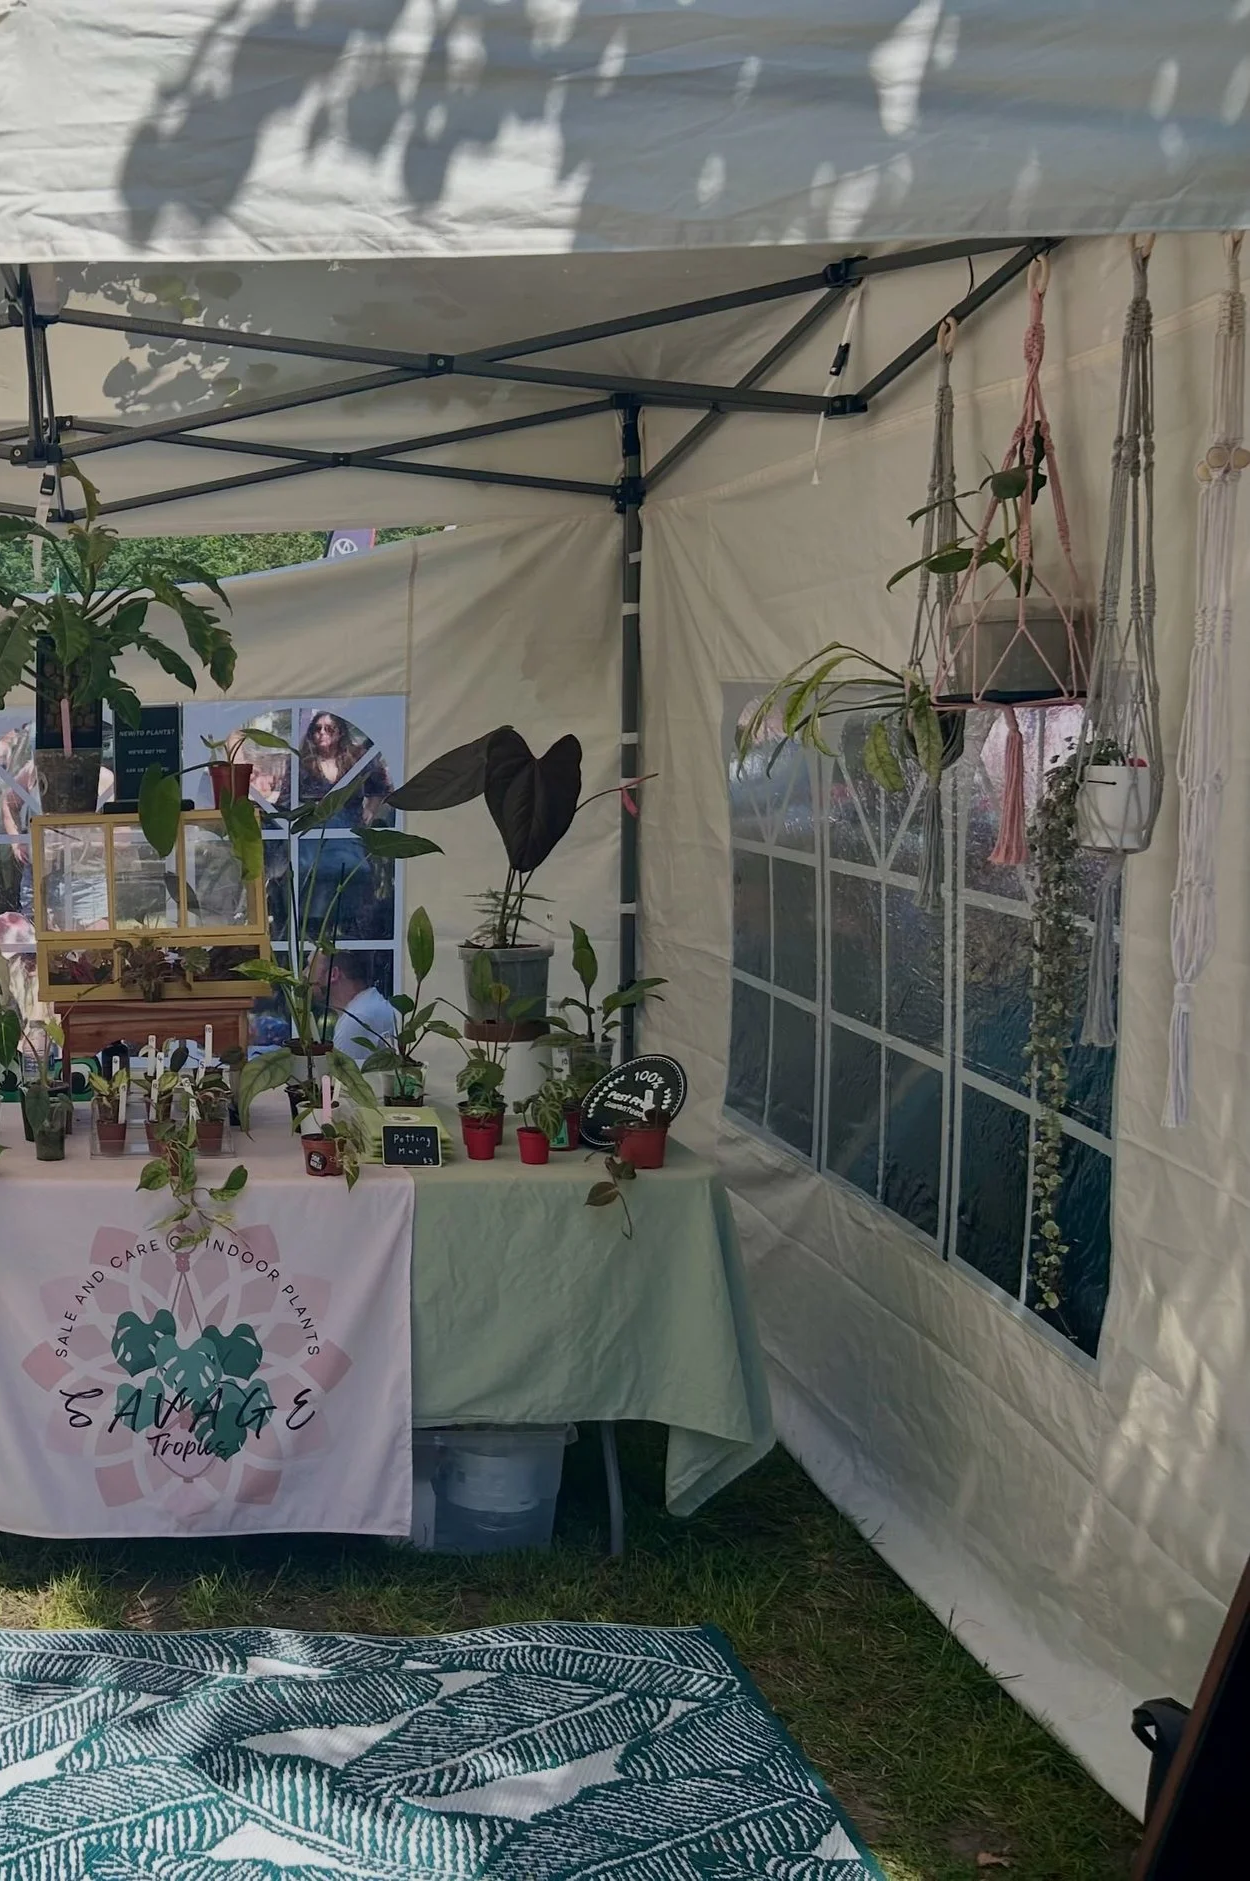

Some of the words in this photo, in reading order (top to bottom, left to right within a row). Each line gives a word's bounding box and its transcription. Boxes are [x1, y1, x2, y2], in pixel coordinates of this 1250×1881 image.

[634, 1070, 666, 1090] 100%
[393, 1133, 431, 1148] Potting
[55, 1310, 78, 1358] SALE
[75, 1270, 105, 1306] AND
[110, 1239, 160, 1268] CARE
[205, 1237, 280, 1282] INDOOR
[282, 1285, 320, 1356] PLANTS
[59, 1387, 319, 1440] SAVAGE
